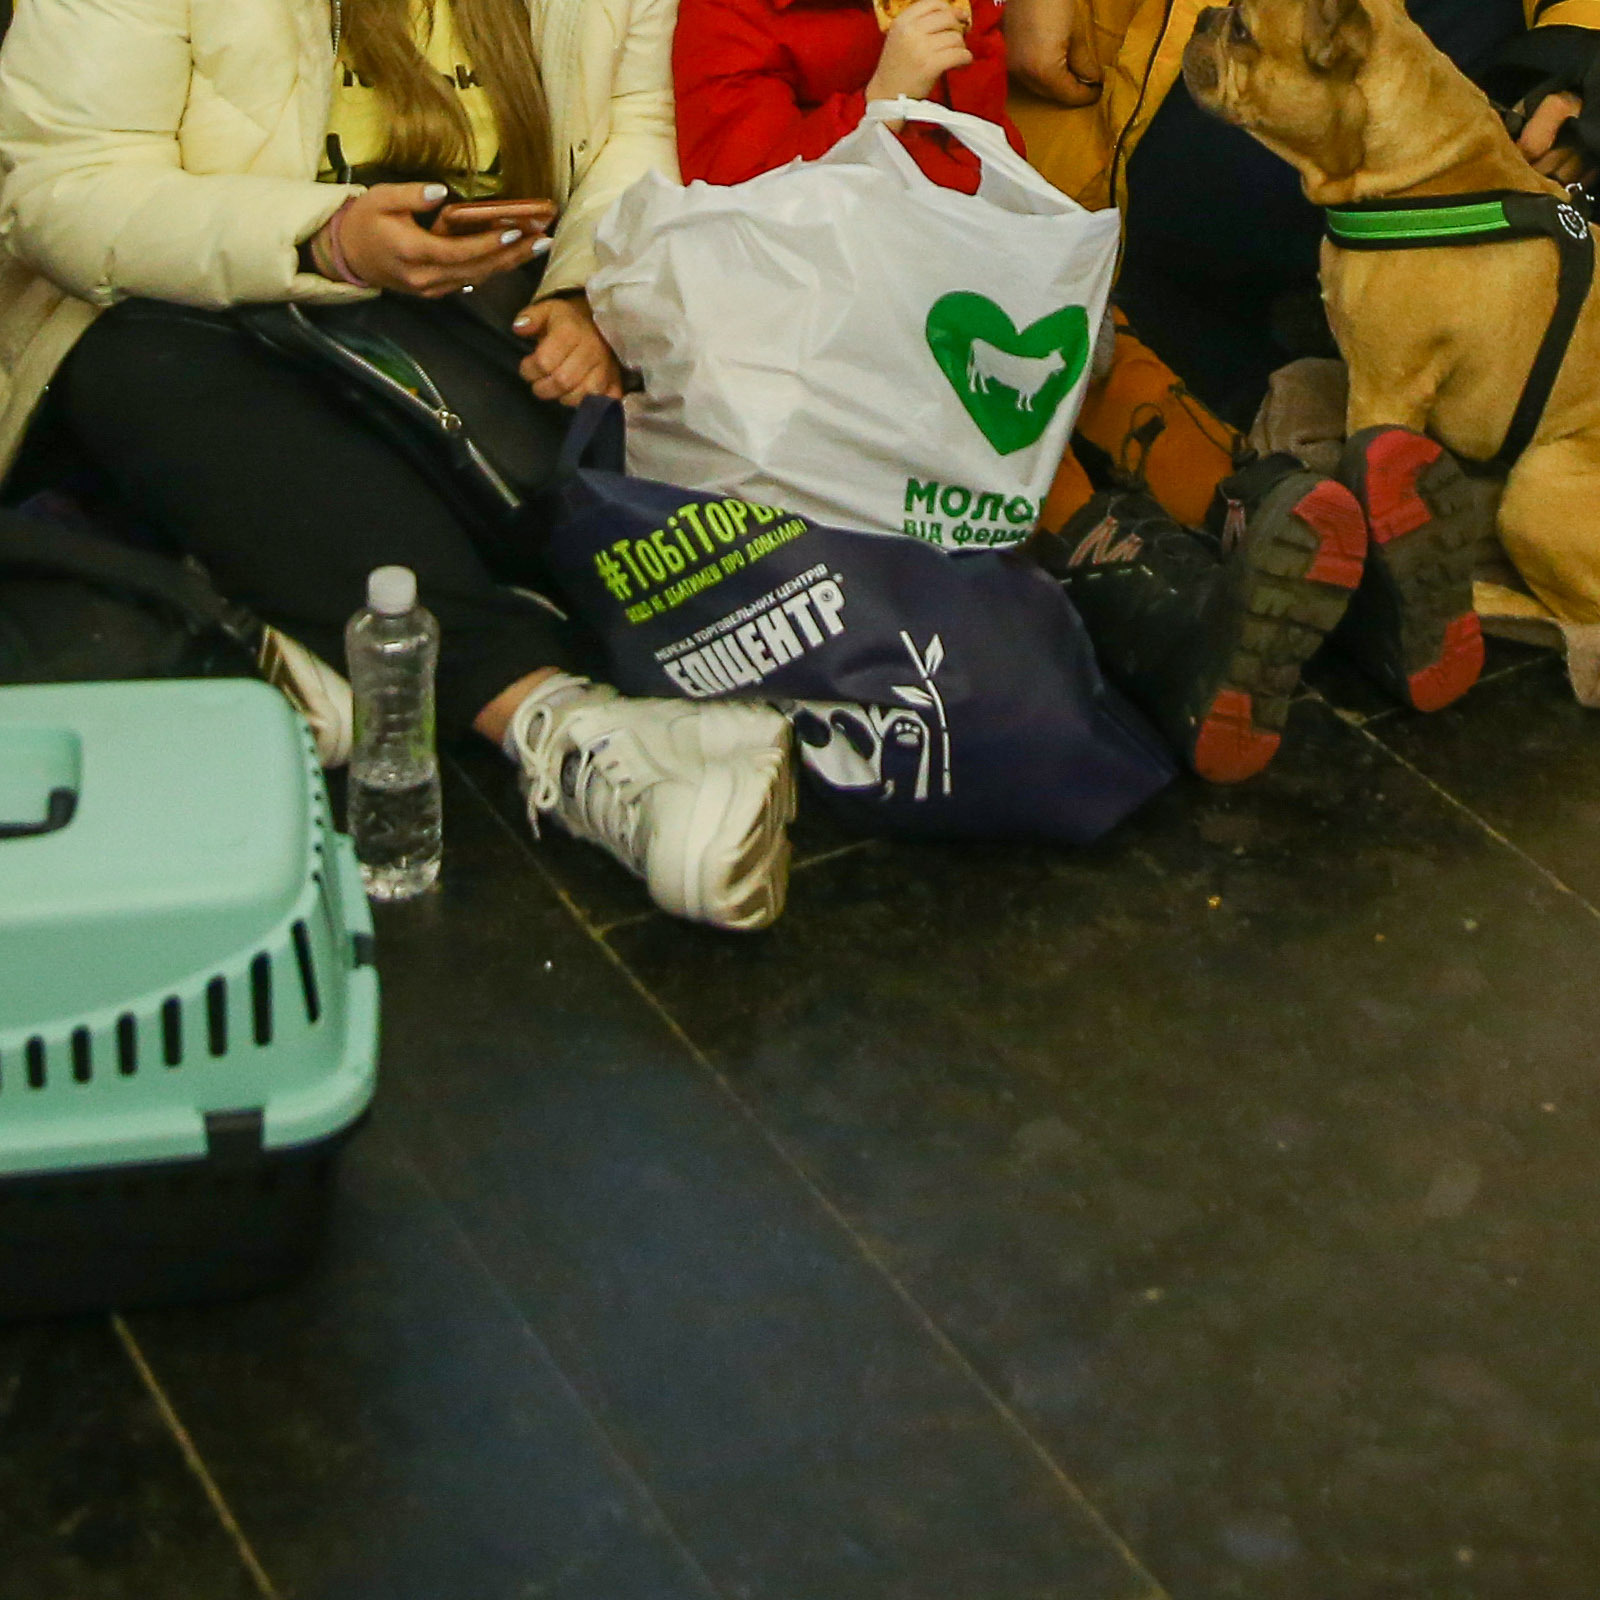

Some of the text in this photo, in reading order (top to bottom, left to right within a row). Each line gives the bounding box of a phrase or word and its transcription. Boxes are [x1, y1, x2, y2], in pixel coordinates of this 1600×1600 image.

[904, 477, 1047, 525] МОЛО
[775, 561, 830, 603] ЦЕНТРІВ
[663, 577, 847, 699] ЕПІЦЕНТР
